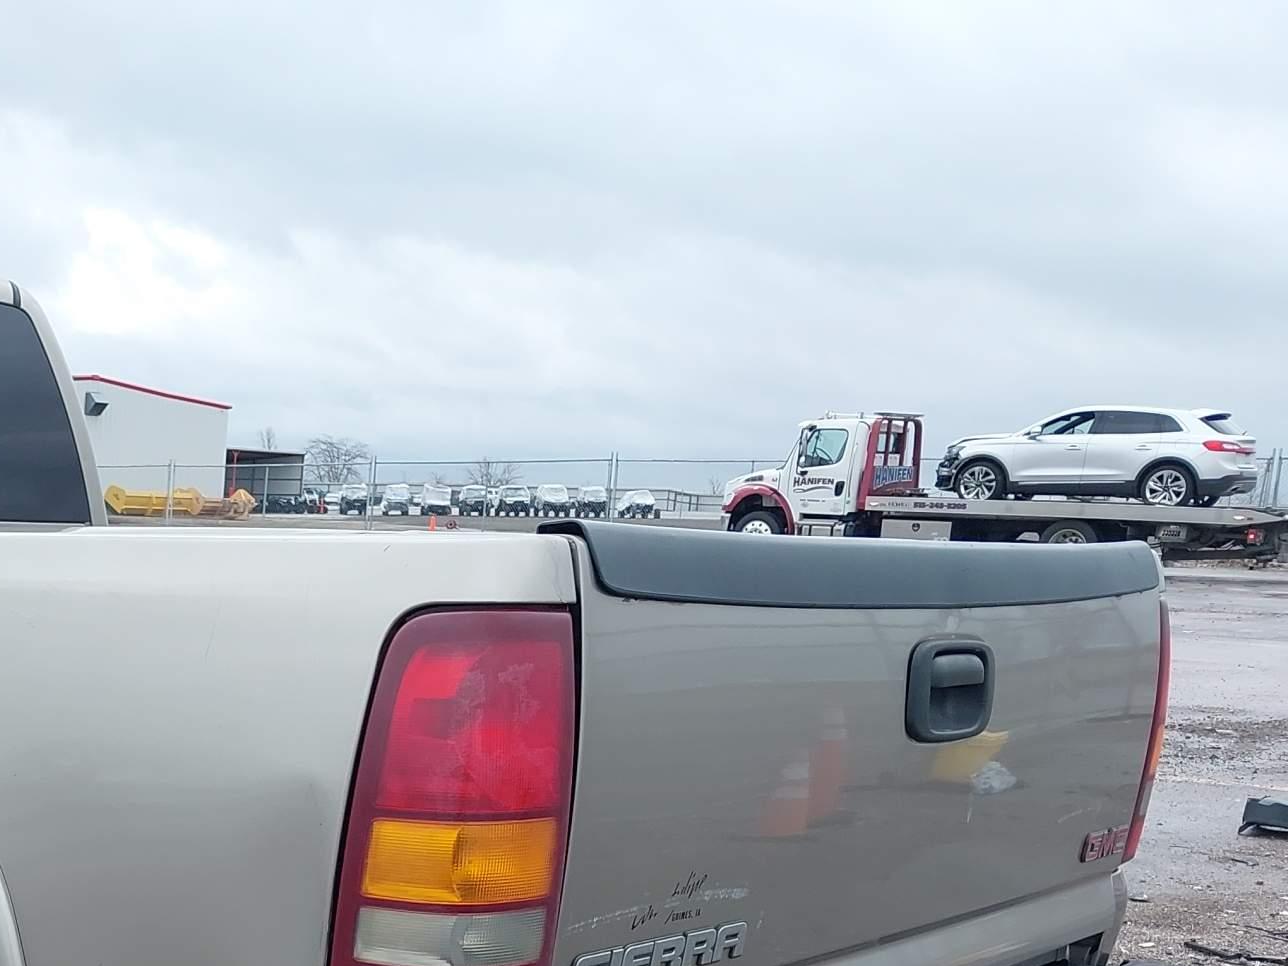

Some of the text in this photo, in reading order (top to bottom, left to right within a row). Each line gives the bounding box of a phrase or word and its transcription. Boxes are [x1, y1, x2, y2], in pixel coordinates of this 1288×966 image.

[793, 476, 835, 488] HANIFEN
[874, 465, 913, 487] HANIFEN
[1080, 825, 1129, 863] GMC
